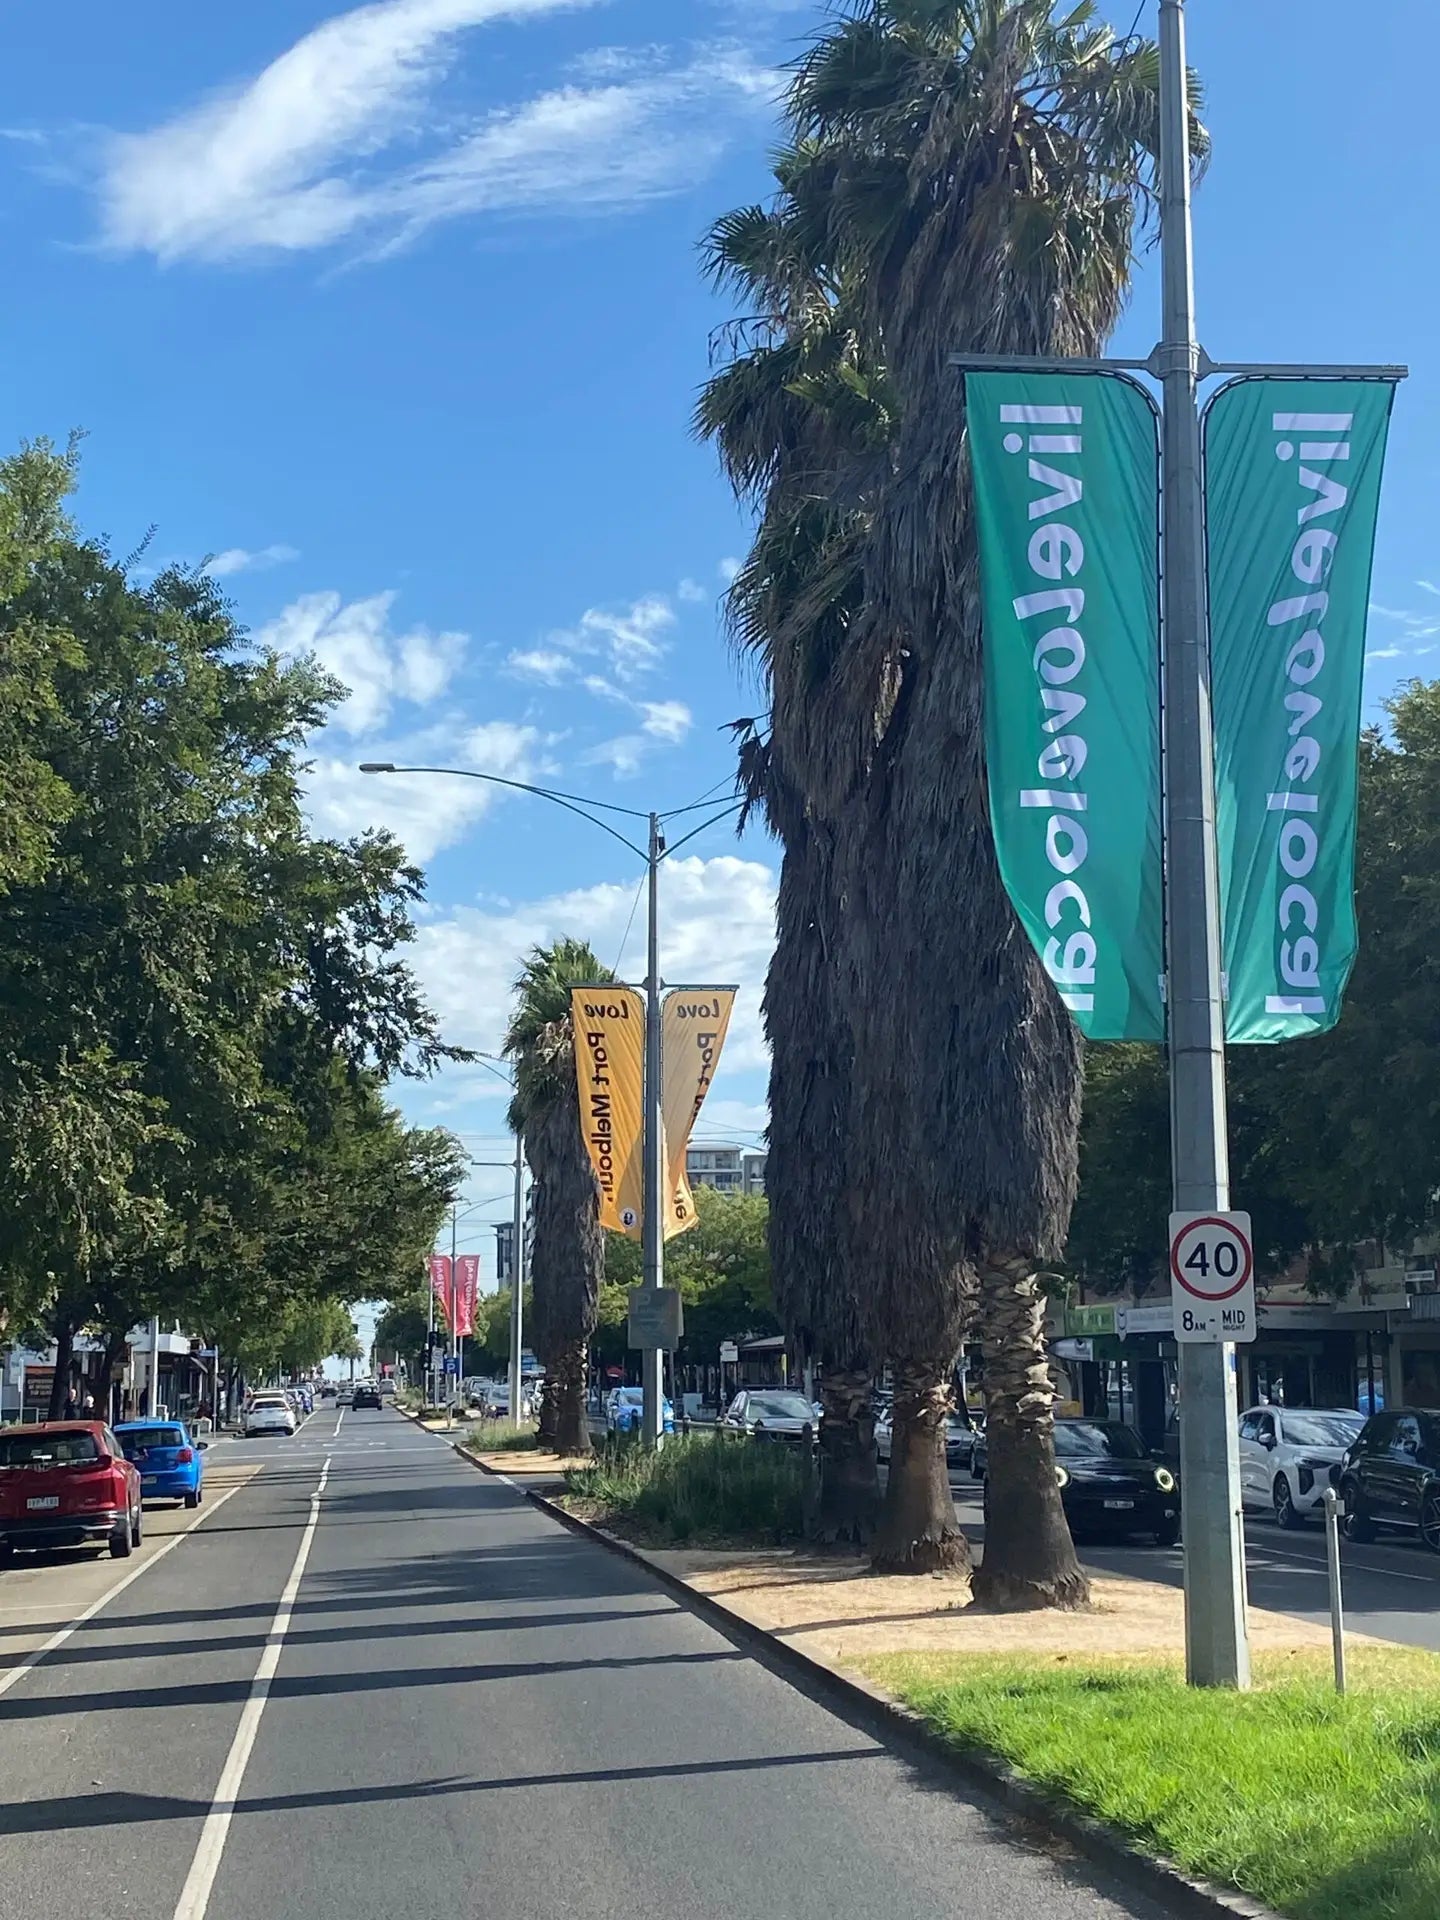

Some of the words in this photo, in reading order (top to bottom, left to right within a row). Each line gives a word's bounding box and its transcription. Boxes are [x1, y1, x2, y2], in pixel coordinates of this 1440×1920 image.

[1184, 1241, 1239, 1278] 40
[1222, 1309, 1246, 1325] MID
[1222, 1324, 1246, 1332] NIGHT
[446, 1362, 456, 1374] P
